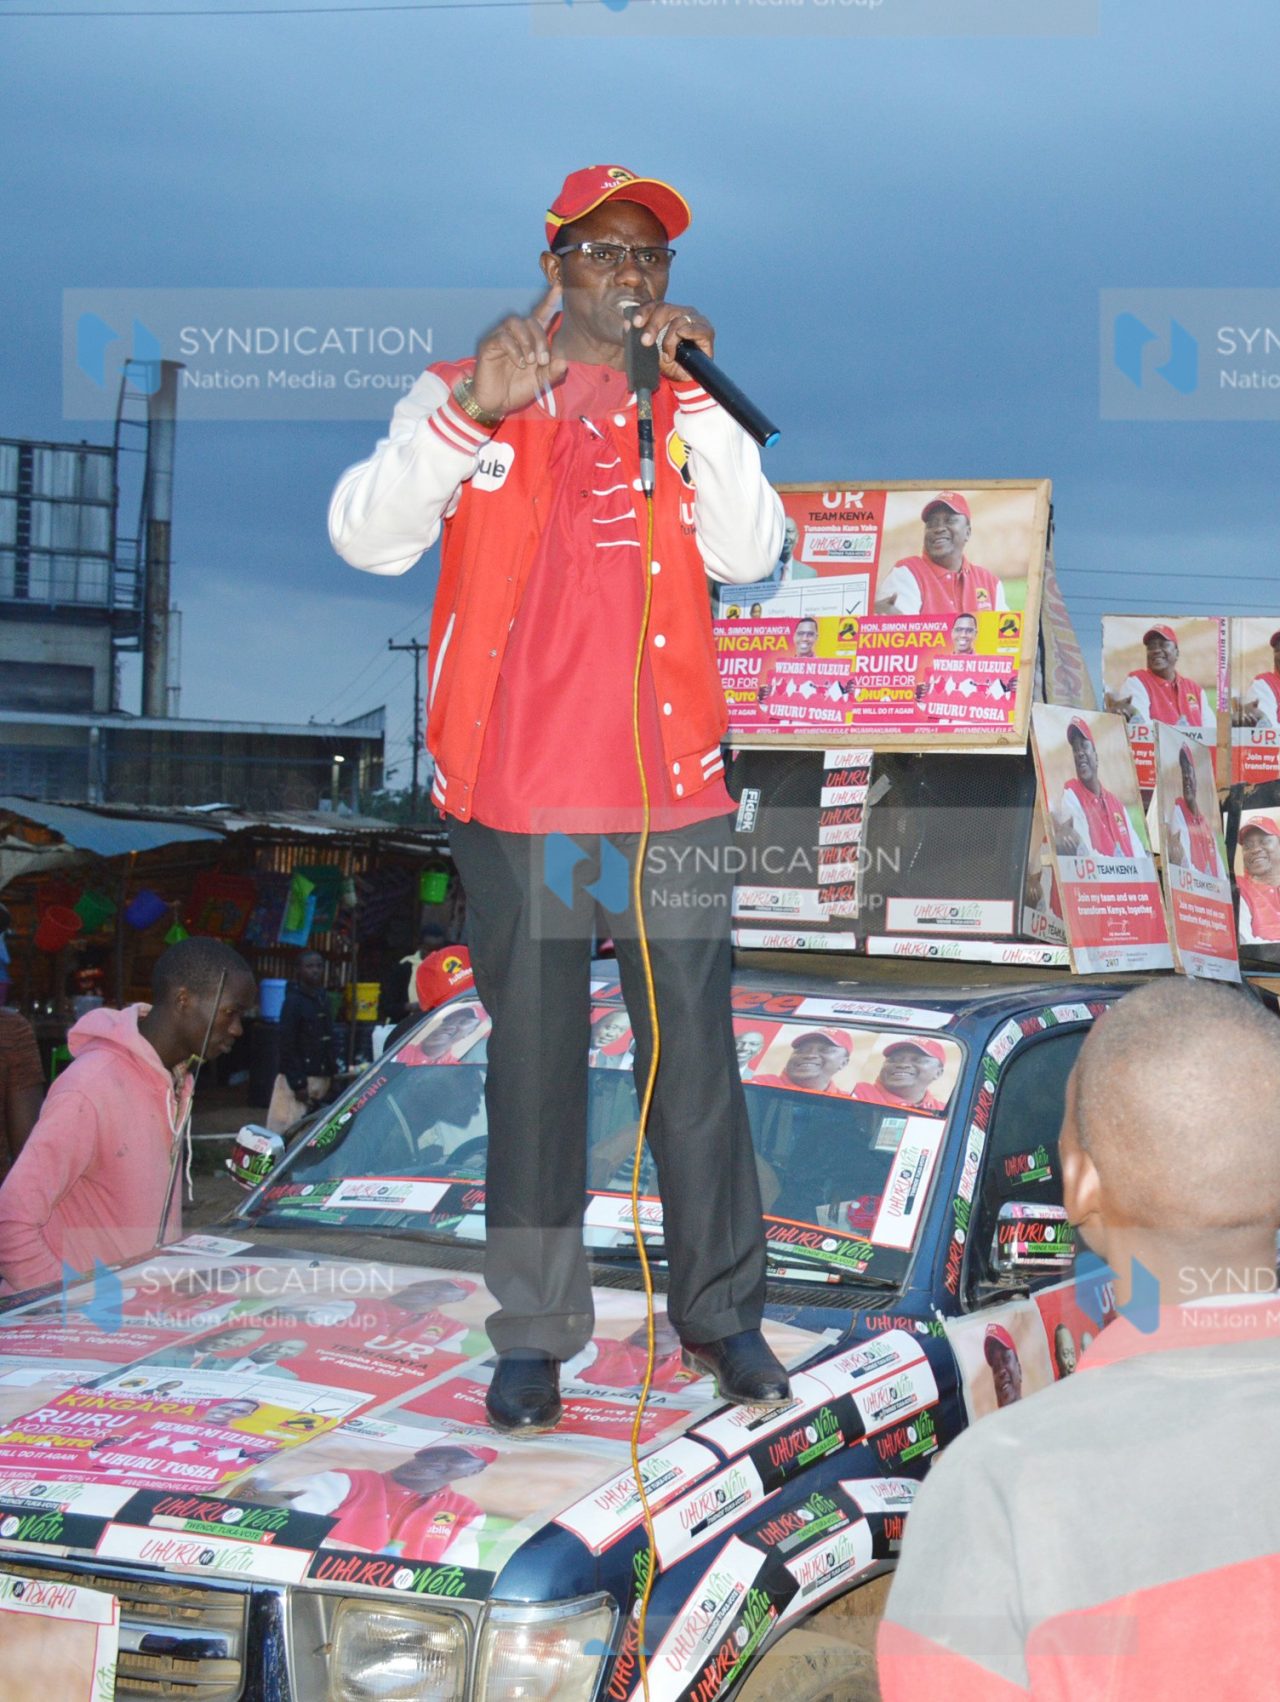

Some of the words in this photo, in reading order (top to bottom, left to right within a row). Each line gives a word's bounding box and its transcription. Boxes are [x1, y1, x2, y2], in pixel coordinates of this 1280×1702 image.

[809, 512, 837, 521] TEAM
[839, 512, 874, 521] KENYA
[728, 627, 752, 635] SIMON
[882, 623, 905, 632] SIMON
[858, 632, 946, 648] KINGARA
[717, 657, 762, 675] UIRU
[856, 655, 918, 672] RUIRU
[933, 658, 965, 672] WEMBE
[966, 660, 977, 672] NI
[737, 677, 759, 688] FOR
[855, 675, 890, 686] VOTED
[893, 675, 916, 686] FOR
[770, 704, 806, 718] UHURU
[809, 708, 843, 721] TOSHA
[928, 703, 967, 717] UHURU
[969, 707, 1005, 720] TOSHA
[1251, 730, 1276, 744] UR
[742, 790, 759, 831] Fidek
[1097, 865, 1116, 875] TEAM
[1116, 865, 1138, 875] KENYA
[999, 1221, 1046, 1244] UHURU
[765, 1225, 824, 1249] UHURU
[837, 1240, 874, 1260] Wetu
[866, 1313, 917, 1334] UHURU
[364, 1335, 434, 1359] UR
[334, 1358, 375, 1372] August
[561, 1387, 609, 1398] TEAM
[57, 1394, 197, 1416] KINGARA
[571, 1405, 602, 1414] and
[26, 1408, 138, 1428] RUIRU
[13, 1422, 73, 1437] VOTED
[75, 1427, 113, 1438] FOR
[769, 1427, 810, 1467] UHURU
[811, 1406, 839, 1440] Wetu
[877, 1427, 911, 1460] UHURU
[44, 1453, 79, 1461] AGAIN
[100, 1452, 166, 1470] UHURU
[161, 1461, 221, 1480] TOSHA
[152, 1497, 228, 1522] UHURU
[240, 1507, 290, 1530] Wetu
[679, 1490, 718, 1530] UHURU
[757, 1510, 806, 1546] UHURU
[803, 1492, 838, 1518] Wetu
[18, 1511, 64, 1540] Wetu
[185, 1521, 217, 1533] TWENDE
[218, 1526, 262, 1540] TUKA-VOTE
[139, 1538, 201, 1566] UHURU
[214, 1545, 254, 1570] Wetu
[316, 1555, 401, 1588] UHURU
[412, 1565, 466, 1596] Wetu
[702, 1616, 722, 1645] TWENDE
[719, 1589, 741, 1621] TUKA-VOTE
[741, 1588, 771, 1633] Wetu
[666, 1610, 712, 1673] UHURU
